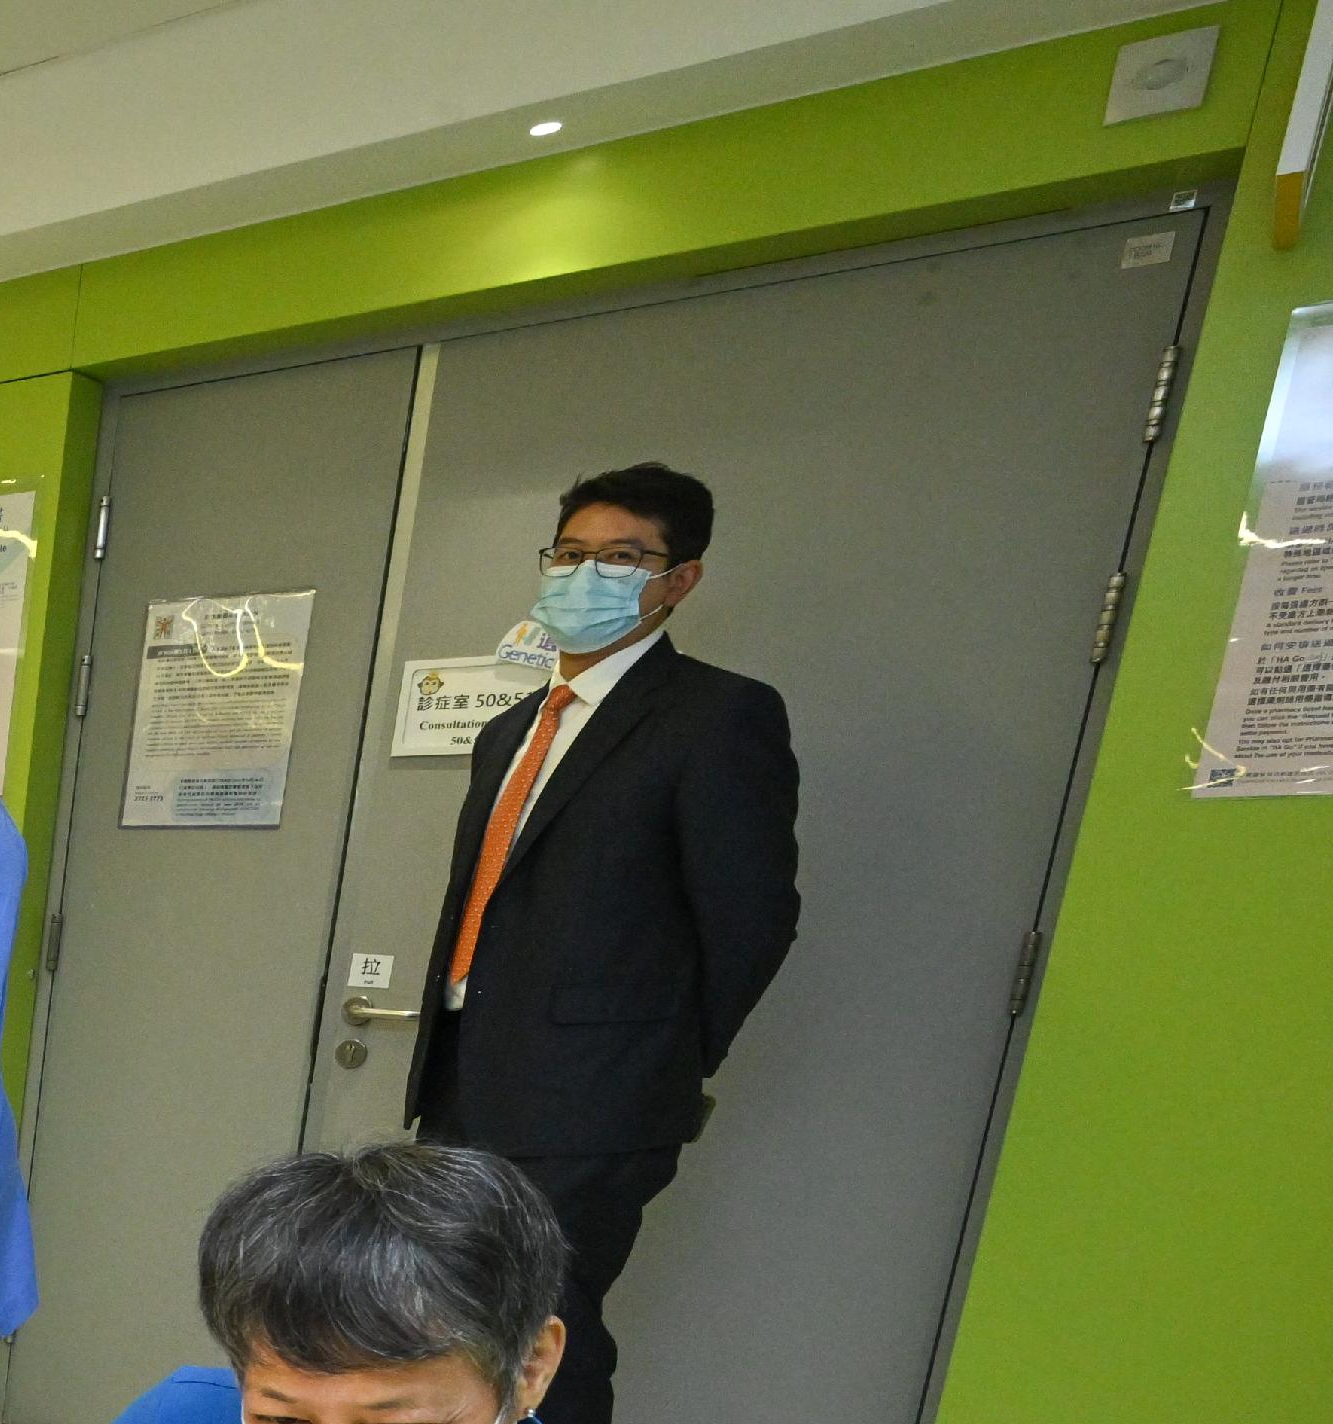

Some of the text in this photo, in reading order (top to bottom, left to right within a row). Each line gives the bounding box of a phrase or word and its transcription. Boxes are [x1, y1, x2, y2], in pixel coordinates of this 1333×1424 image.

[498, 644, 555, 669] Genetic
[416, 694, 470, 711] 診症室
[361, 957, 381, 976] 拉
